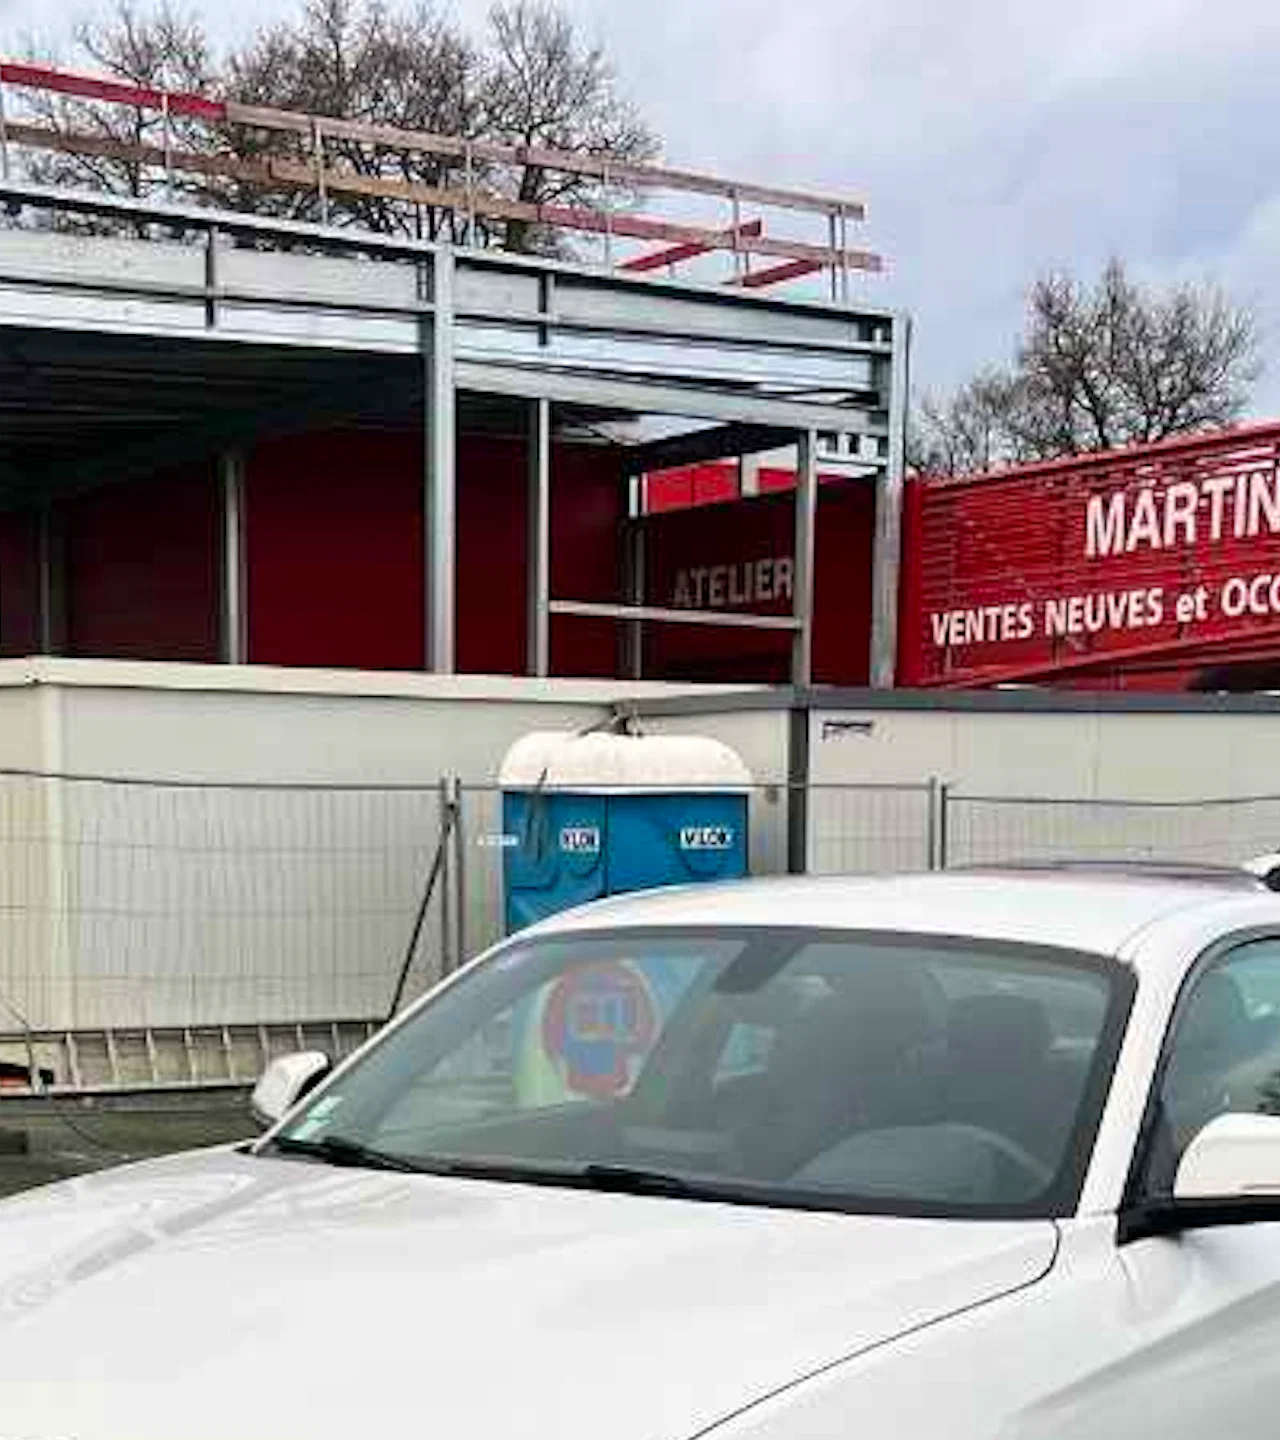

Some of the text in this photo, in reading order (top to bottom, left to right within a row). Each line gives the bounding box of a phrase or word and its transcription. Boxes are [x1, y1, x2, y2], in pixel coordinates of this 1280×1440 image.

[673, 557, 795, 608] ATELIER
[931, 602, 1032, 646] VENTES
[1044, 587, 1164, 636] NEUVES
[1176, 586, 1209, 622] et
